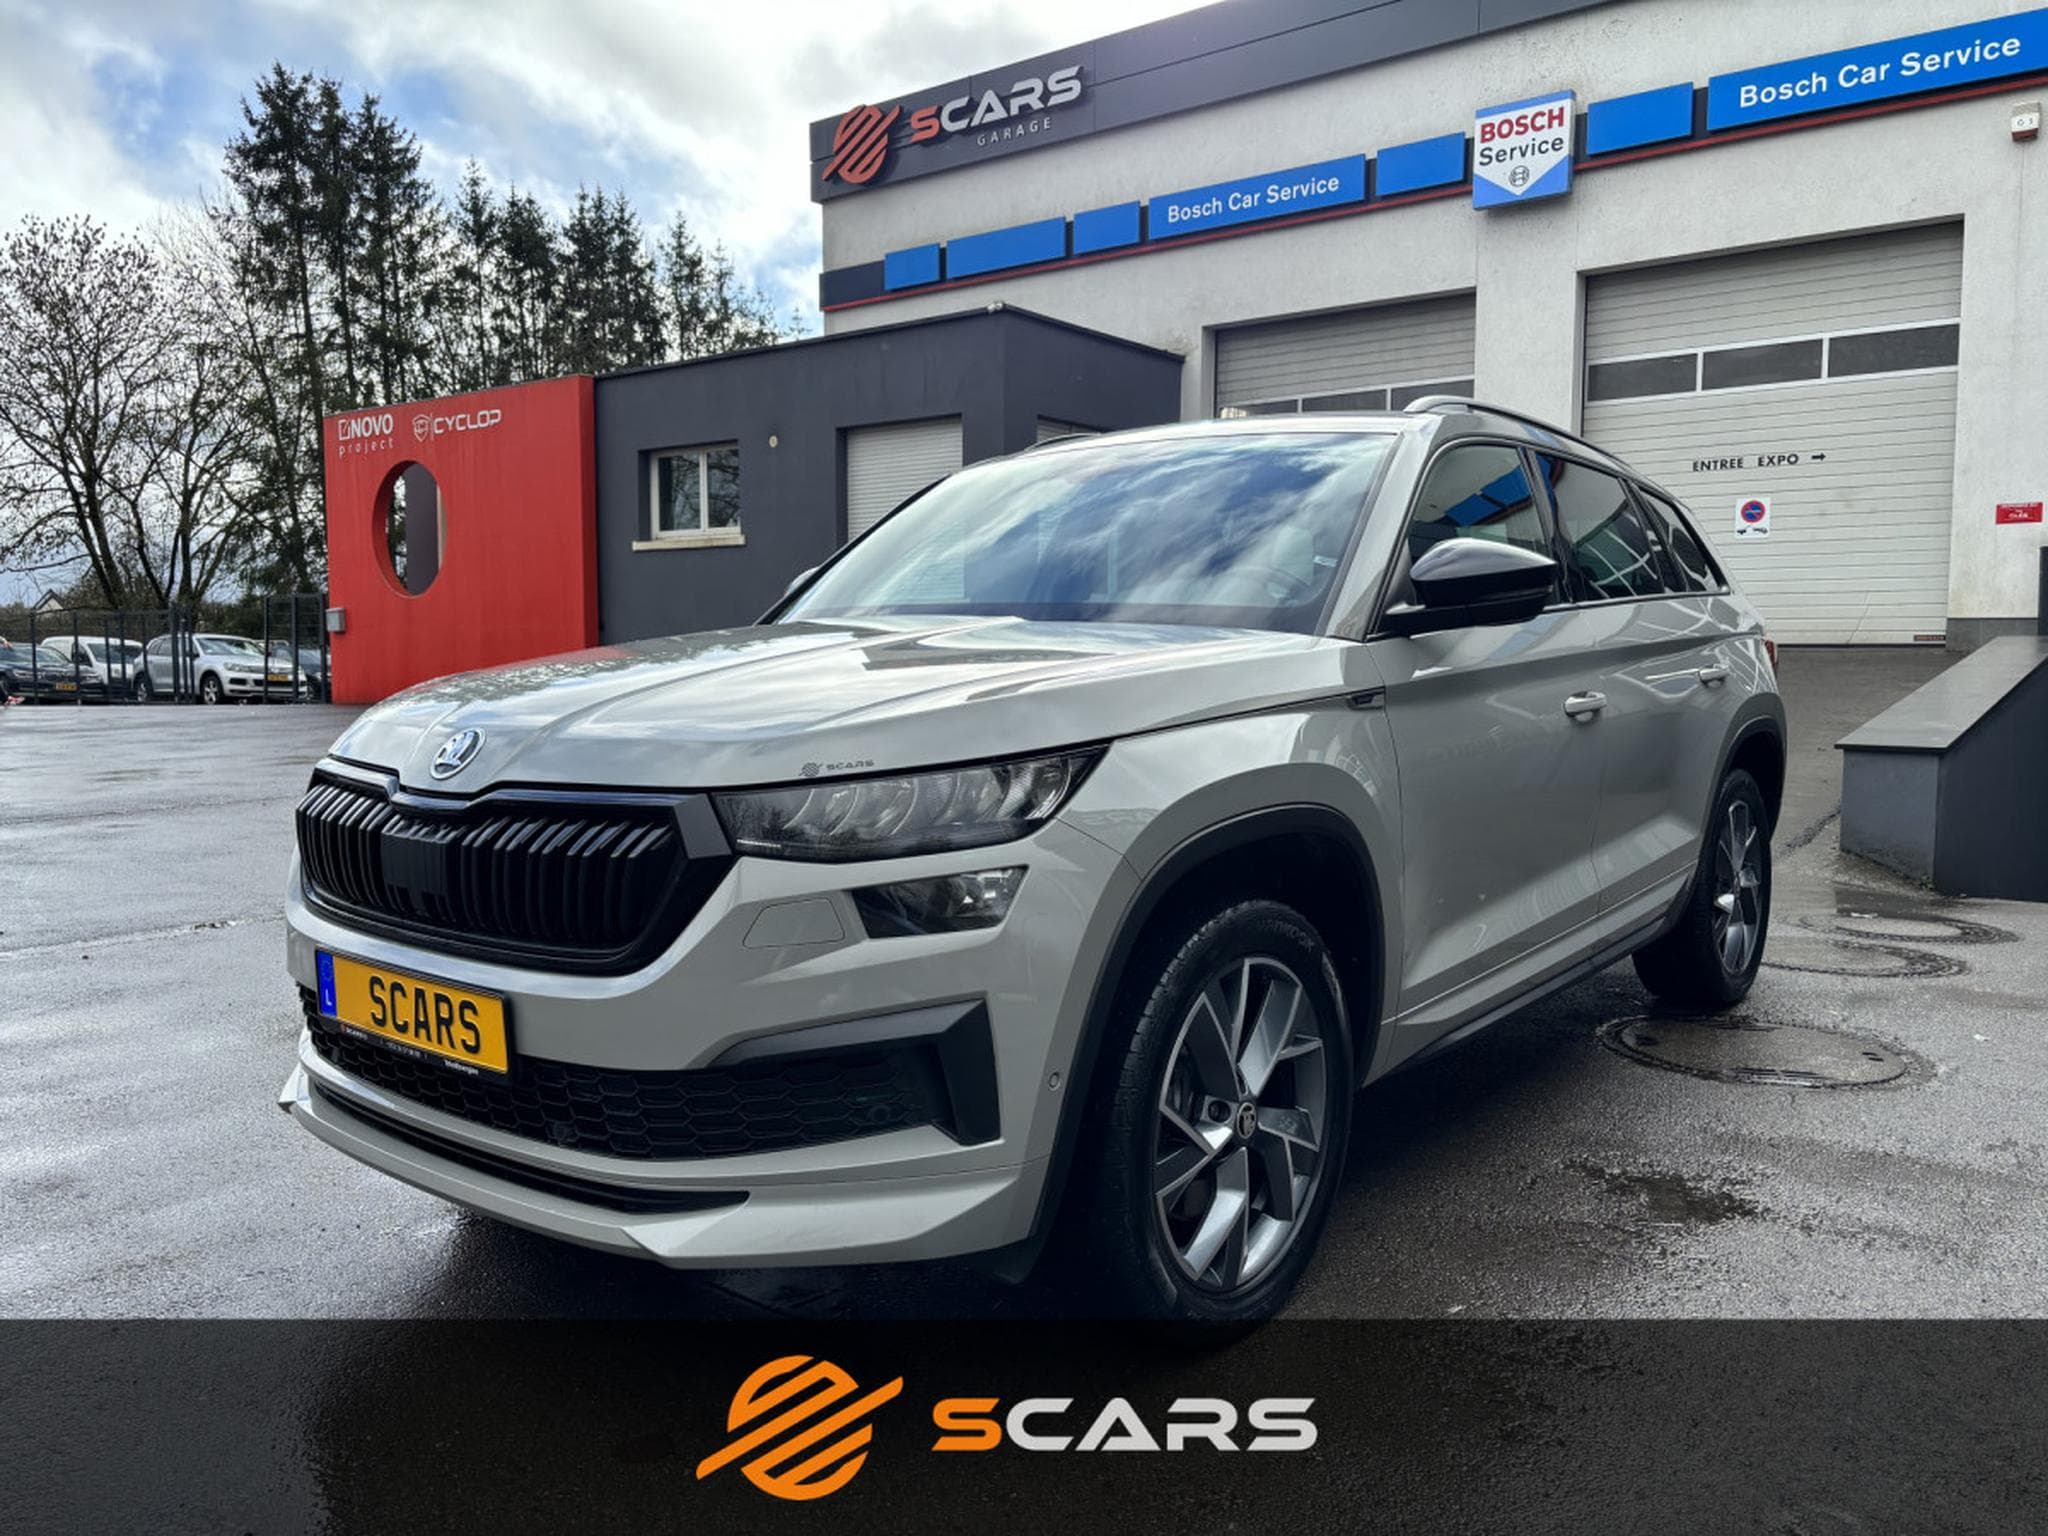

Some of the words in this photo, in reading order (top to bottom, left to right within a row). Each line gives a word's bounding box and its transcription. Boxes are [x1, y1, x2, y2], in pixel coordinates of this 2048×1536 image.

[1739, 72, 1828, 108] Bosch
[1838, 63, 1890, 88] Car
[1900, 37, 2021, 76] Service
[910, 66, 1083, 143] SCARS
[977, 118, 1051, 146] GARAGE
[1480, 106, 1565, 144] BOSCH
[1479, 137, 1564, 166] Service
[1167, 197, 1223, 223] Bosch
[1228, 192, 1261, 211] Car
[1266, 176, 1340, 204] Service
[433, 409, 502, 434] CYCLOP
[338, 437, 394, 458] project
[1692, 457, 1744, 472] ENTREE
[1757, 453, 1799, 467] EXPO
[324, 988, 333, 1006] L
[369, 975, 481, 1054] SCARS
